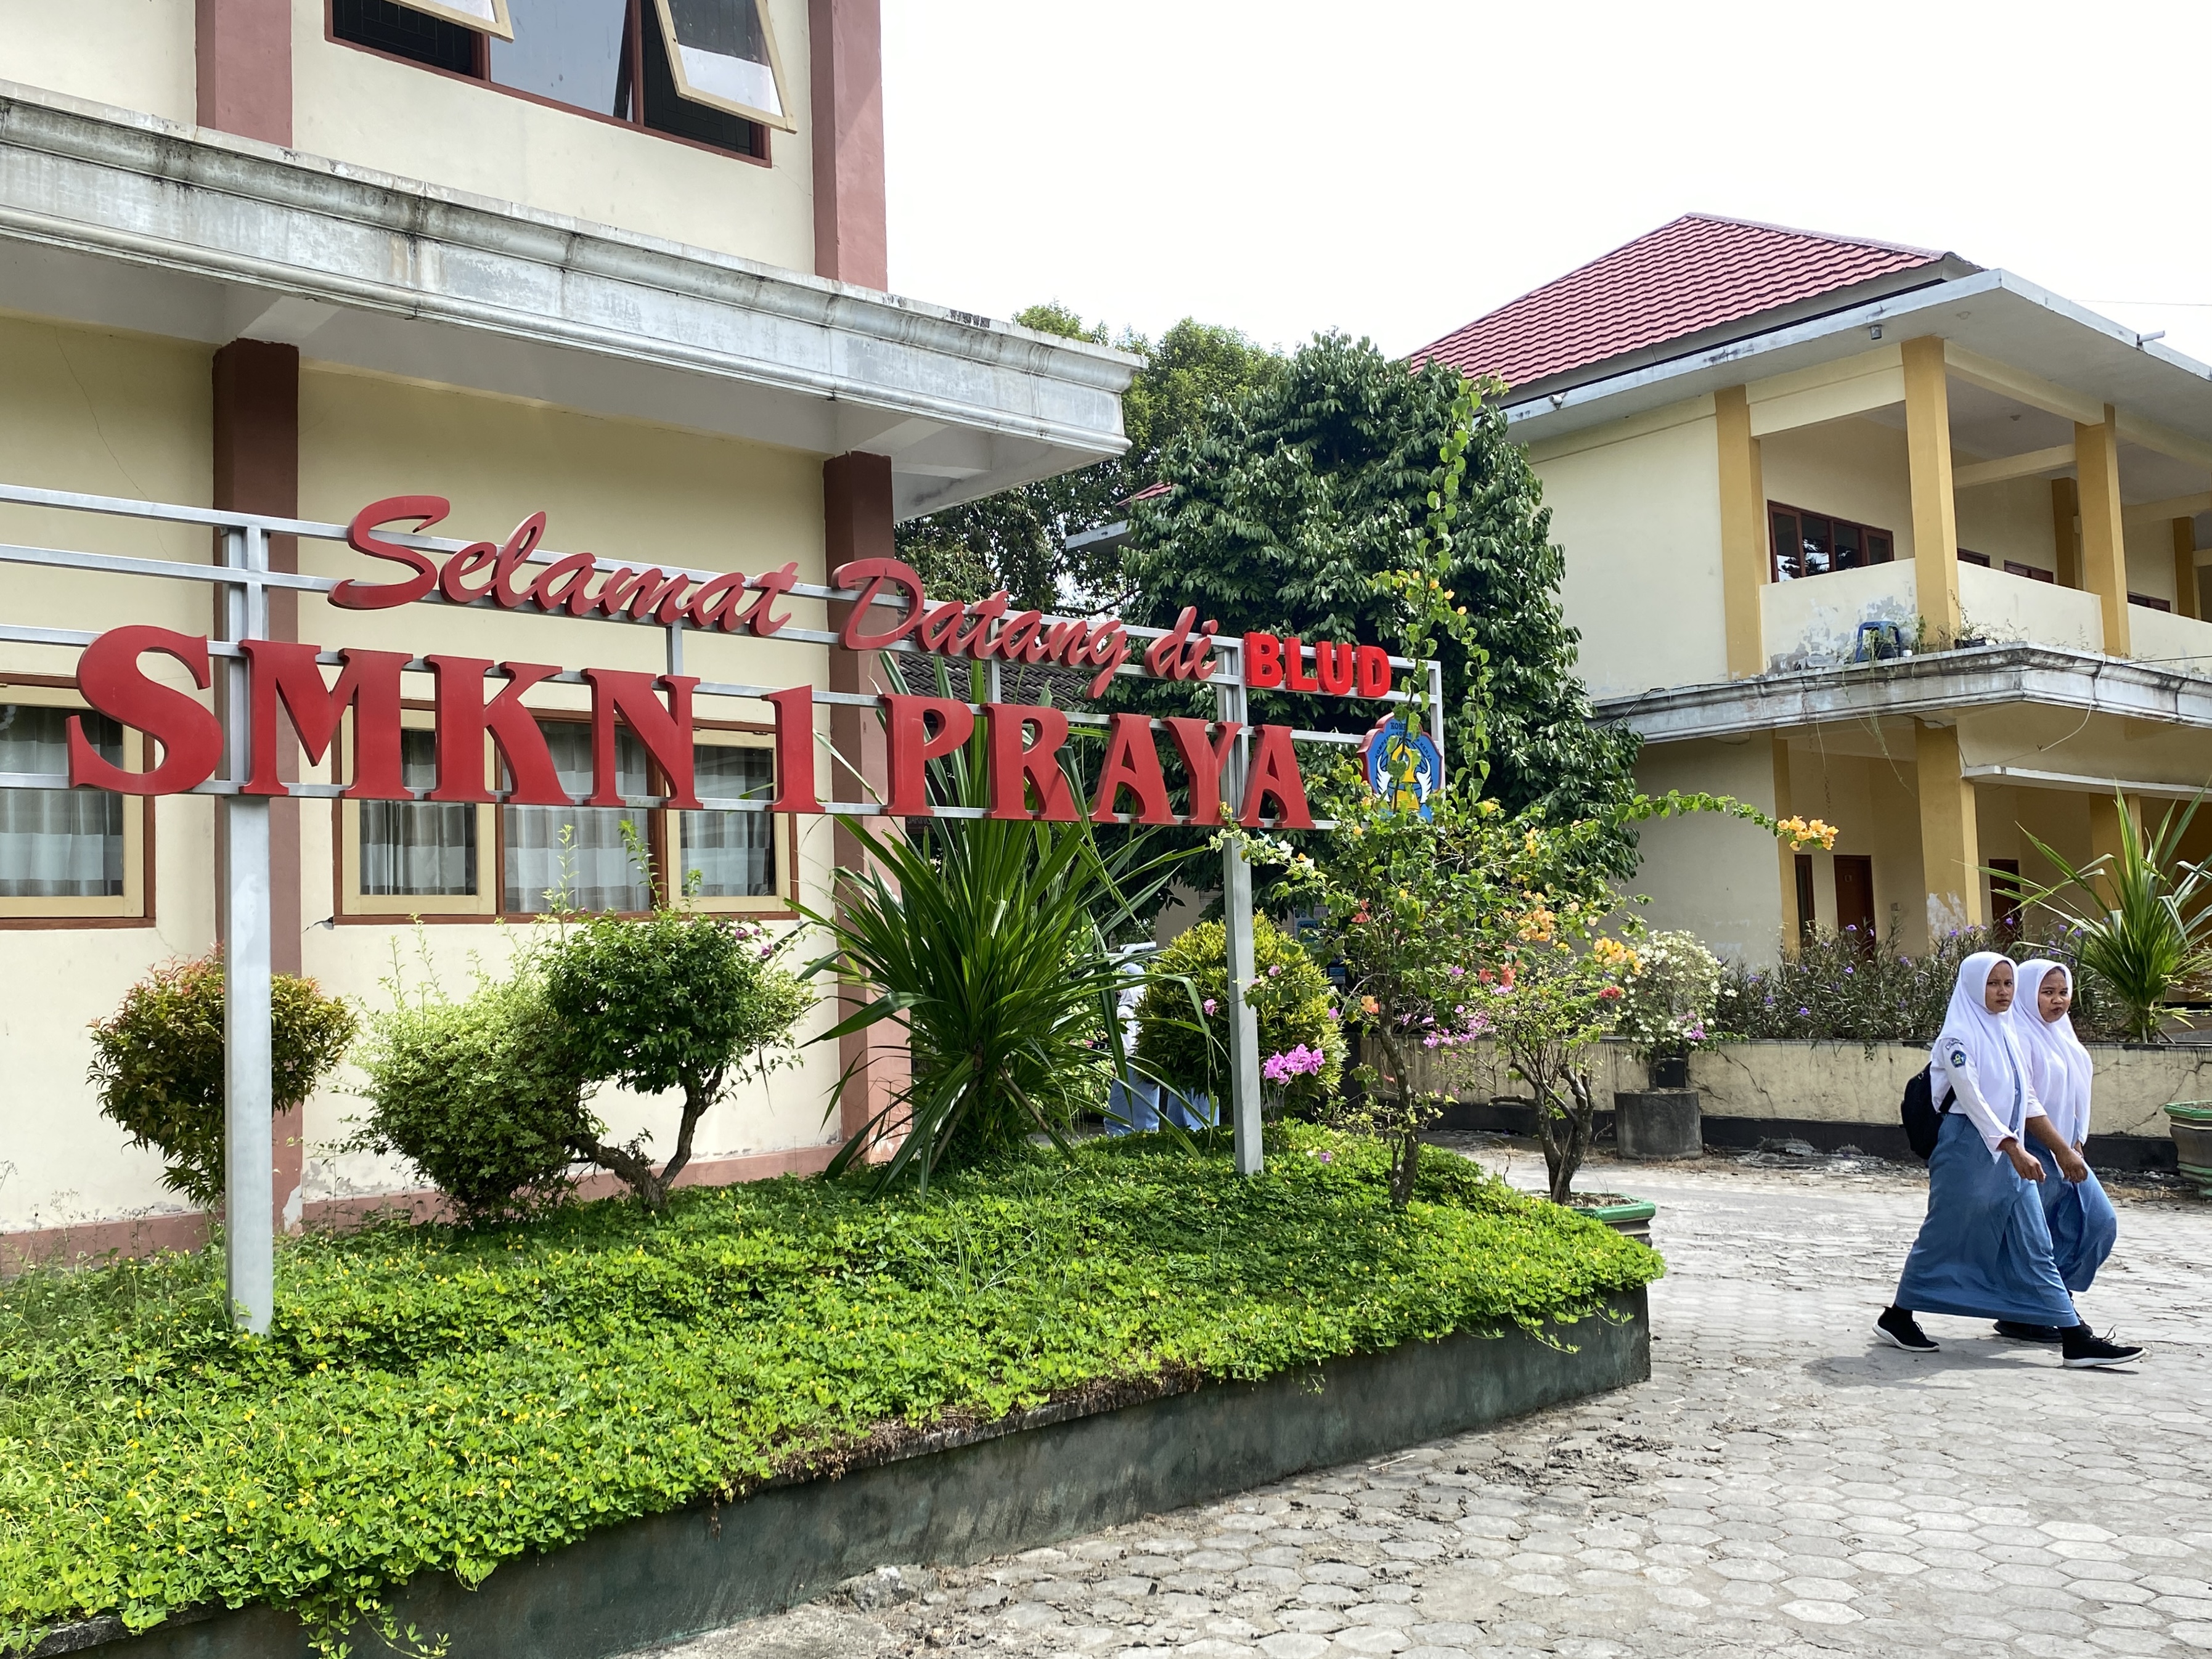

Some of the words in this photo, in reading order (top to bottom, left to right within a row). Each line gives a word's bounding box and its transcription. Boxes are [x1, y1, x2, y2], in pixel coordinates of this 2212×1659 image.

[329, 495, 799, 637] Selamat
[831, 558, 1131, 699] Datang
[1144, 606, 1218, 681] di
[1244, 632, 1392, 698] BLUD
[65, 625, 704, 810] SMKN
[761, 685, 825, 813] 1
[878, 693, 1315, 830] PRAYA
